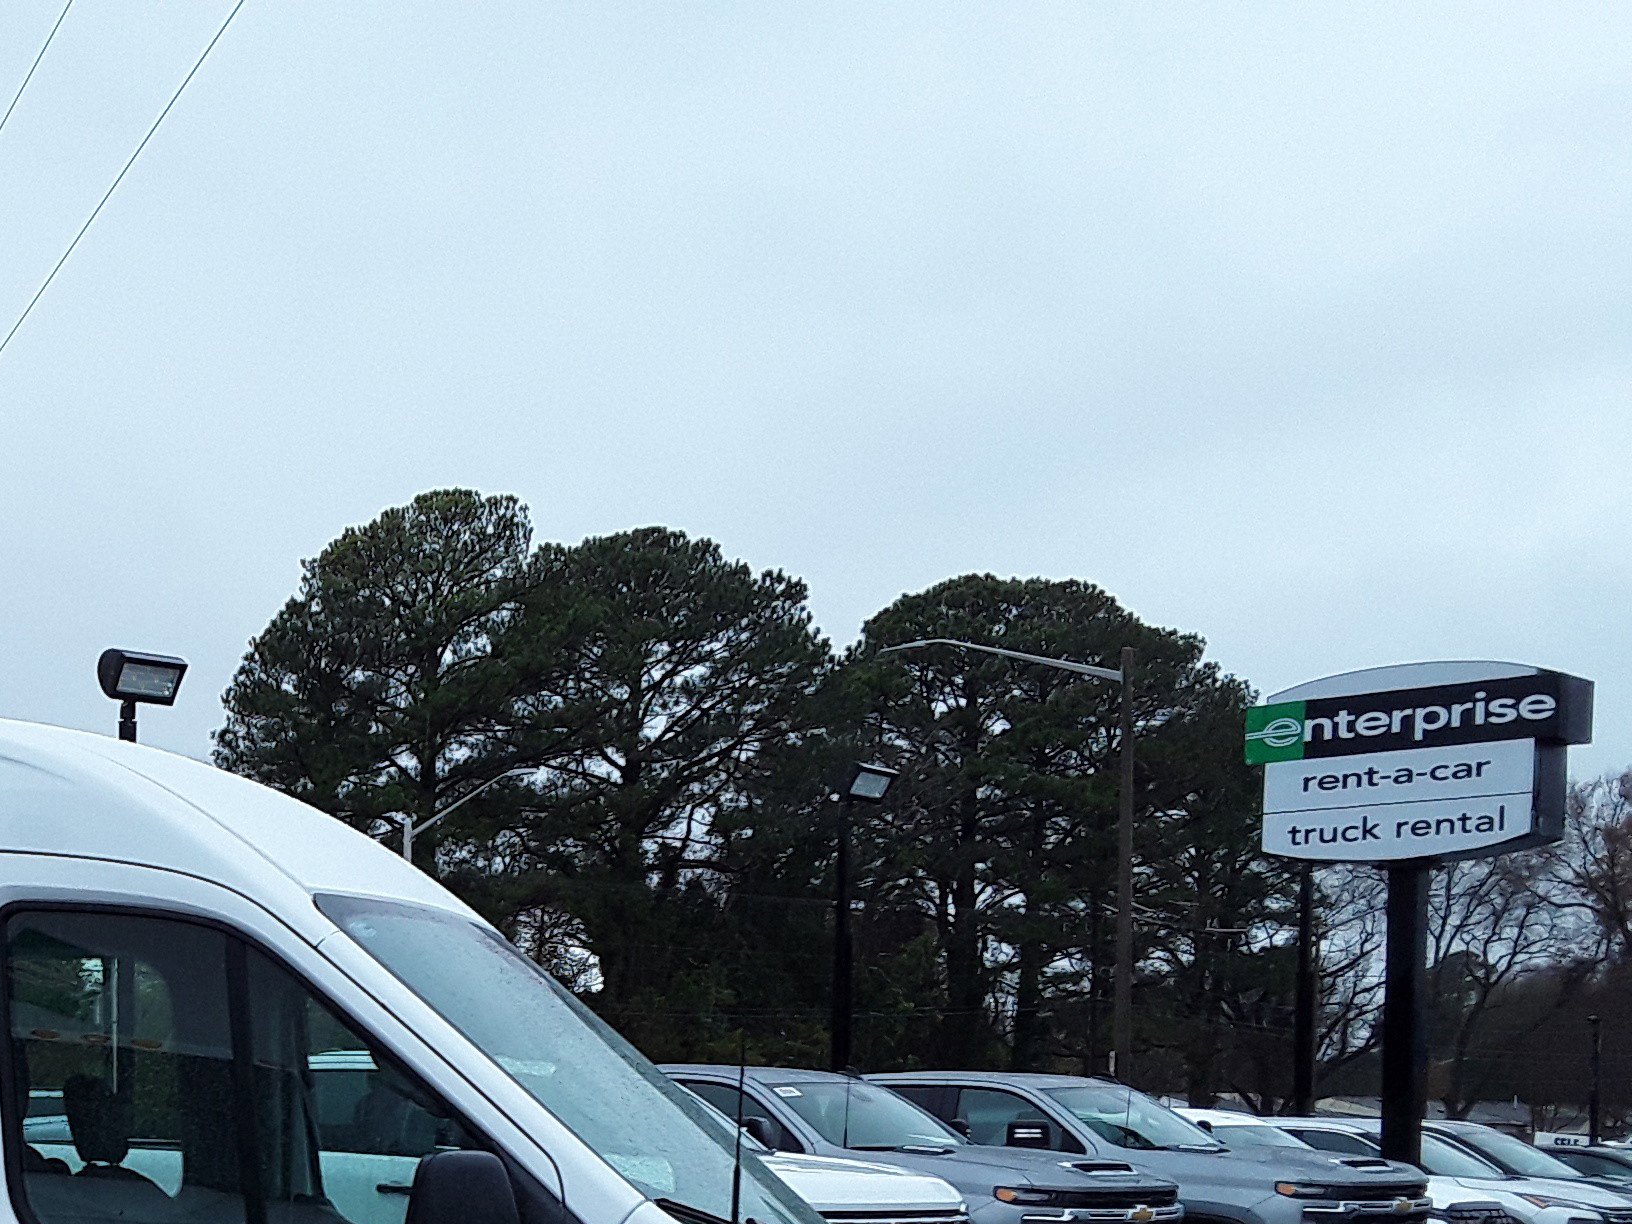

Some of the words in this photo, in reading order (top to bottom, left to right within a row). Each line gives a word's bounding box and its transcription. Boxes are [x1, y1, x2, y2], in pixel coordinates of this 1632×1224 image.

[1245, 691, 1555, 747] enterprise
[1303, 758, 1491, 792] rent-a-car
[1288, 816, 1381, 846] truck
[1396, 805, 1505, 839] rental
